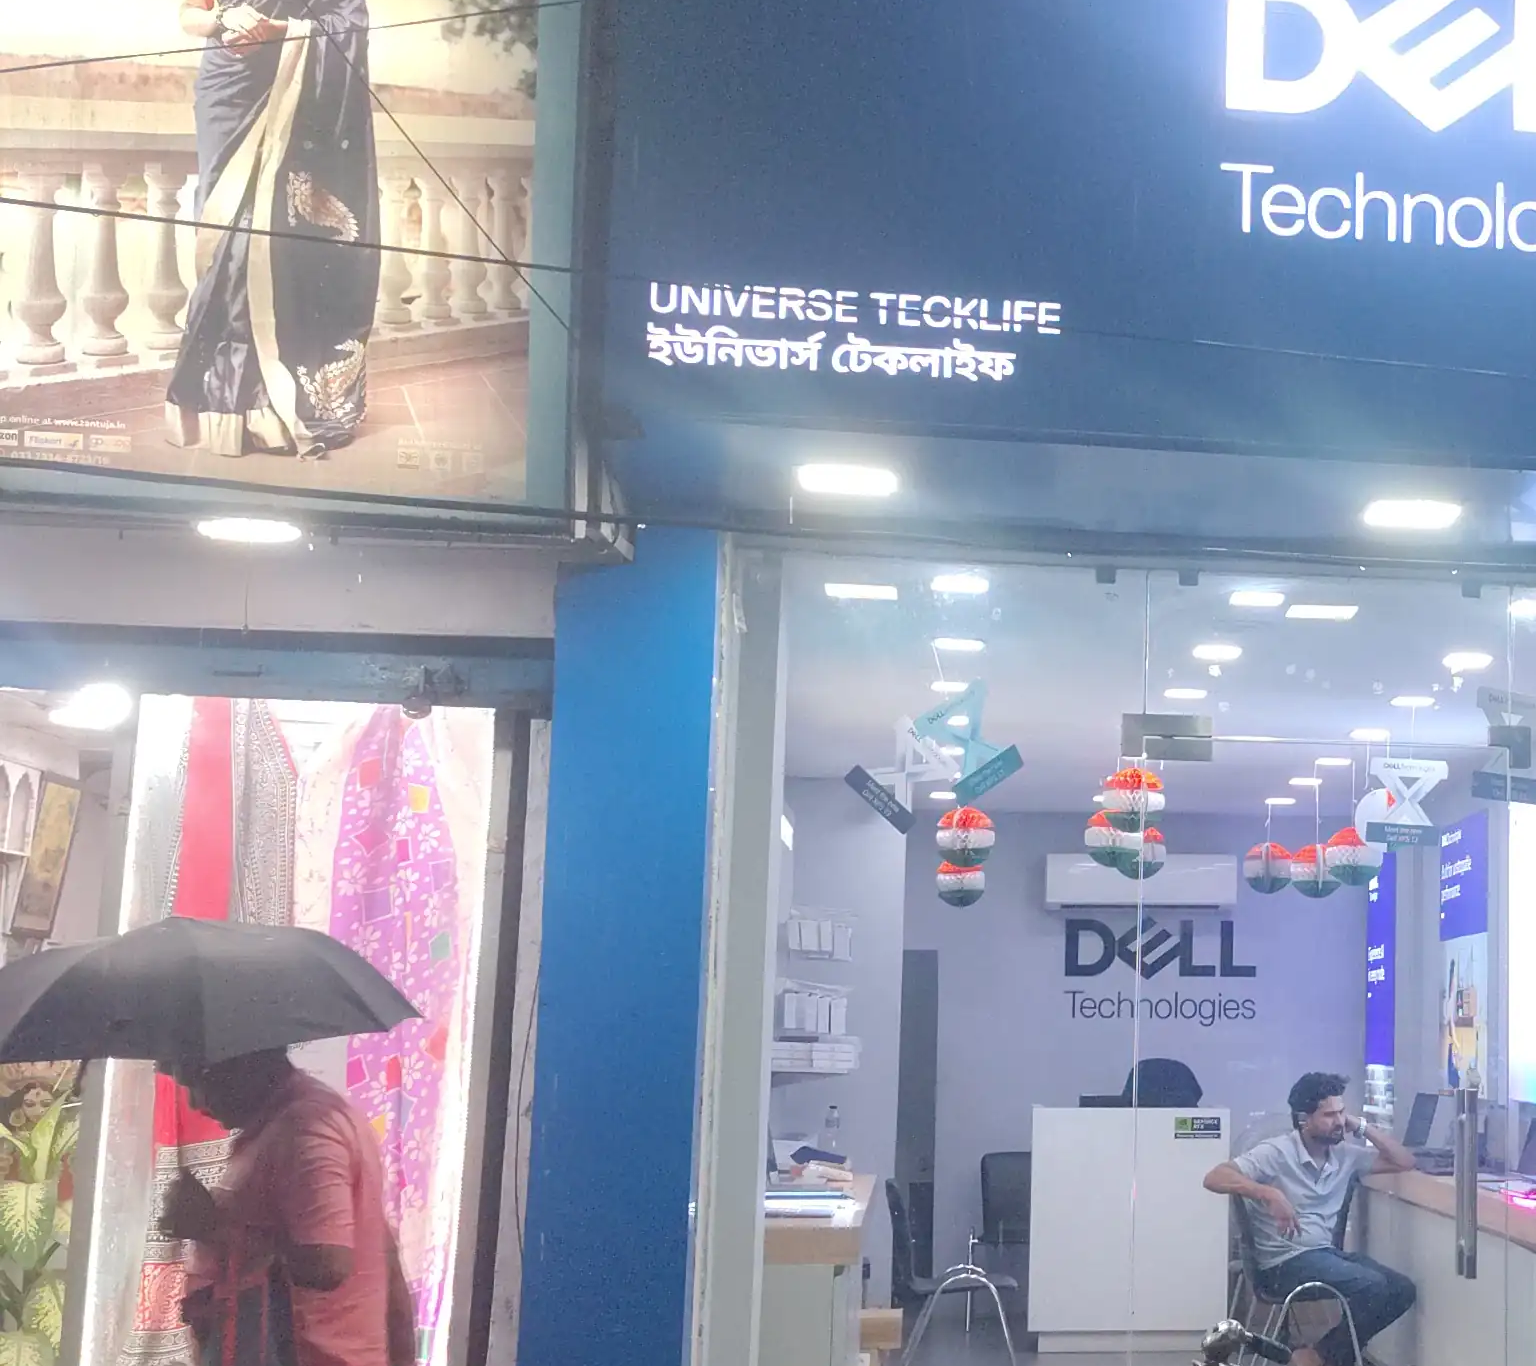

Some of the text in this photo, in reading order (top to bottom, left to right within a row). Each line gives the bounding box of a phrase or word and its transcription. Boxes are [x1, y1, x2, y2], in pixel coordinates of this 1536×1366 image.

[649, 281, 1062, 335] UNIVERSE TECKLIFE
[646, 322, 1017, 381] ইউনিভার্স টেকলাইফ
[1064, 917, 1257, 980] DELL
[1063, 990, 1257, 1027] Technologies
